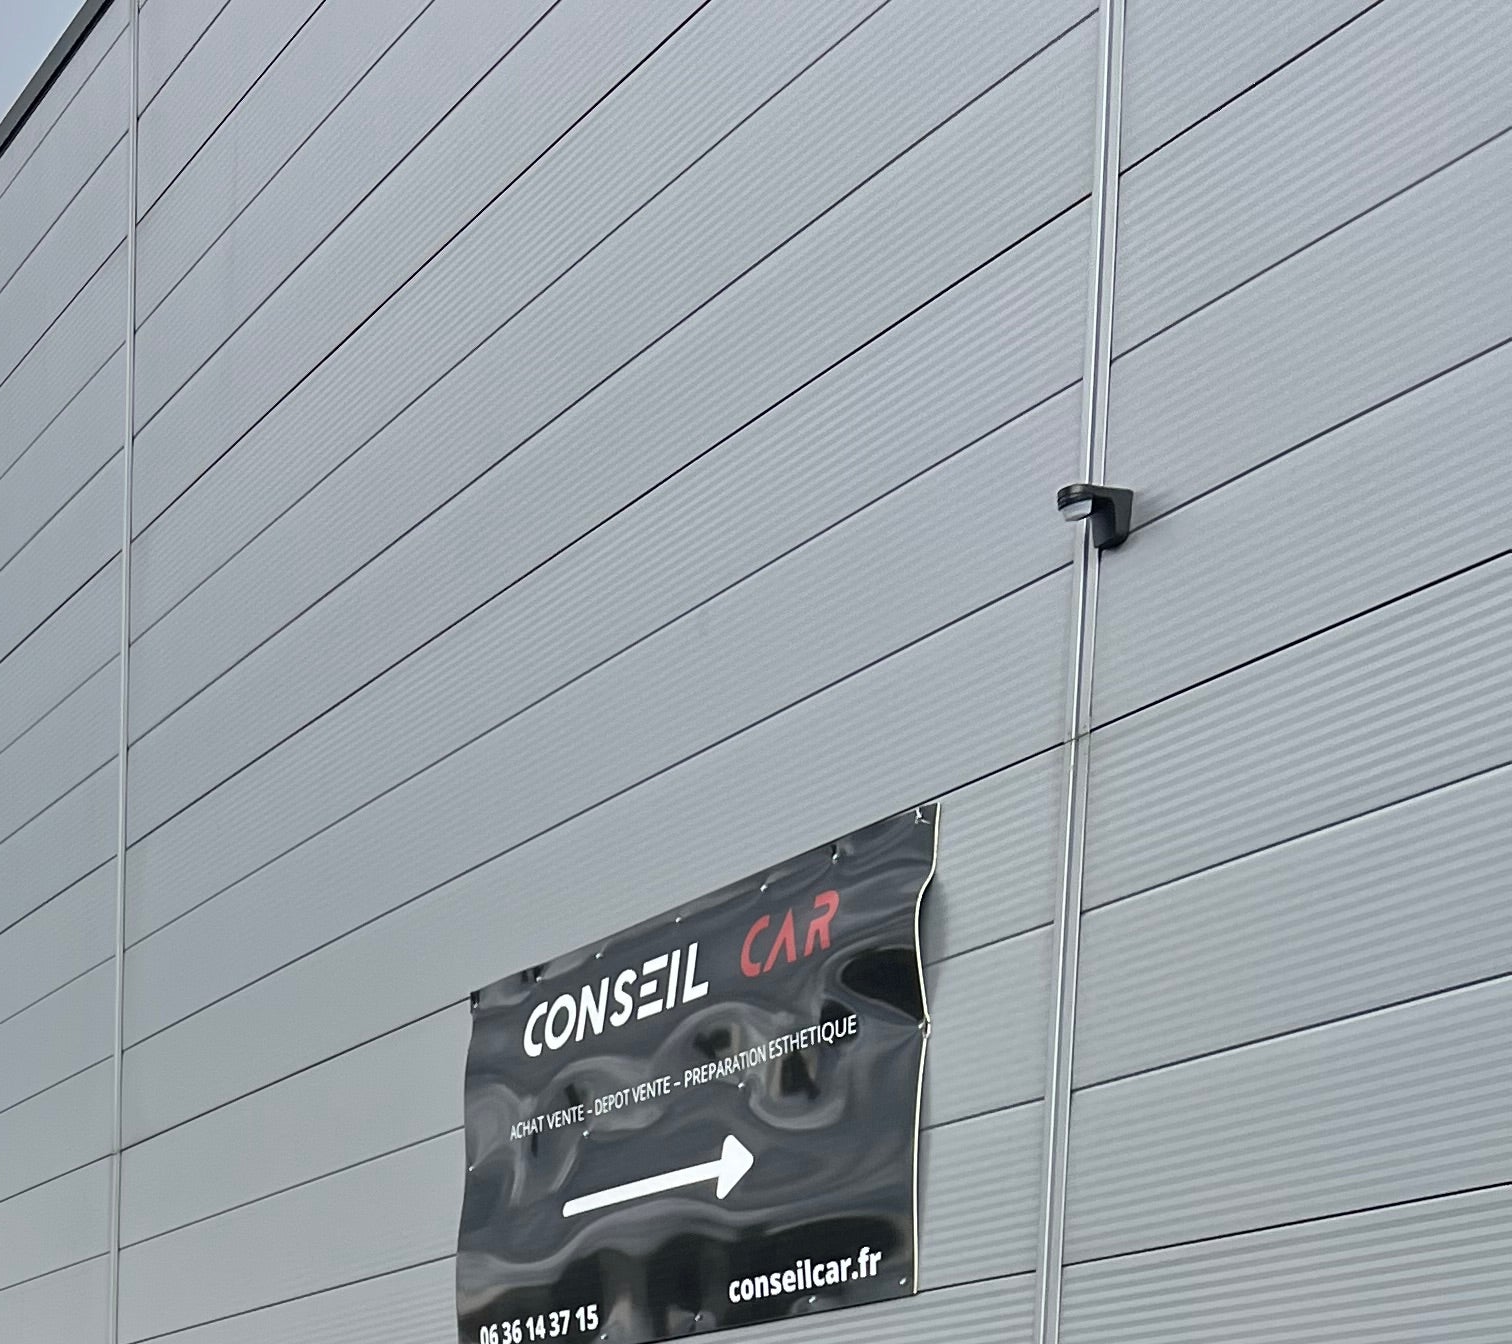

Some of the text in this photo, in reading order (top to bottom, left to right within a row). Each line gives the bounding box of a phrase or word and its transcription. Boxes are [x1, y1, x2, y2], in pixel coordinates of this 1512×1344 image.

[523, 890, 840, 1058] CONSEIL CAR
[509, 1115, 545, 1141] ACHAT
[546, 1104, 585, 1131] VENTE
[594, 1088, 631, 1116] DEPOT
[632, 1076, 671, 1104] VENTE
[684, 1044, 767, 1089] PREPARATION
[768, 1014, 857, 1060] ESTHETIQUE
[728, 1246, 883, 1303] conseilcar.fr
[525, 1314, 546, 1341] 14
[548, 1309, 571, 1338] 37
[575, 1304, 599, 1332] 15
